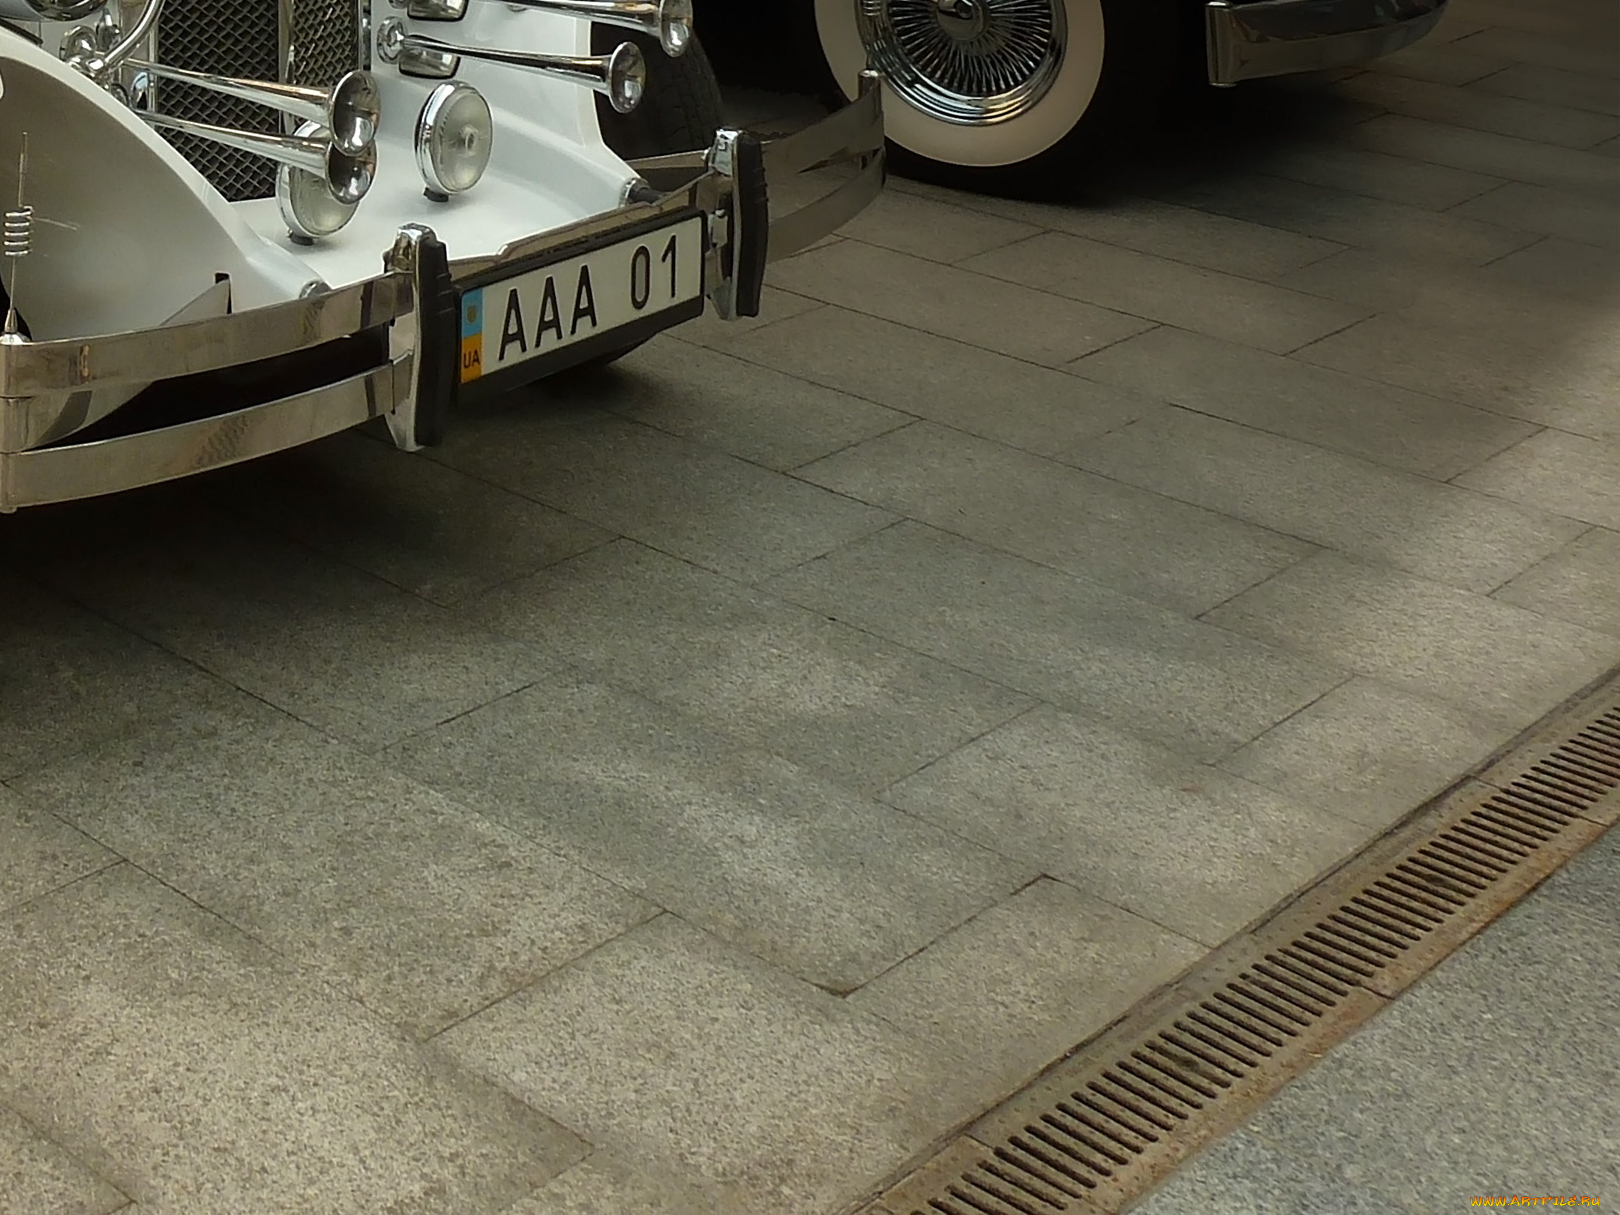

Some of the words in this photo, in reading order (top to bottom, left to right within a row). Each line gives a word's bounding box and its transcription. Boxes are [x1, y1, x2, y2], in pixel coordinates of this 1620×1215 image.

[498, 264, 597, 361] AAA
[630, 234, 678, 310] 01
[463, 346, 482, 370] UA
